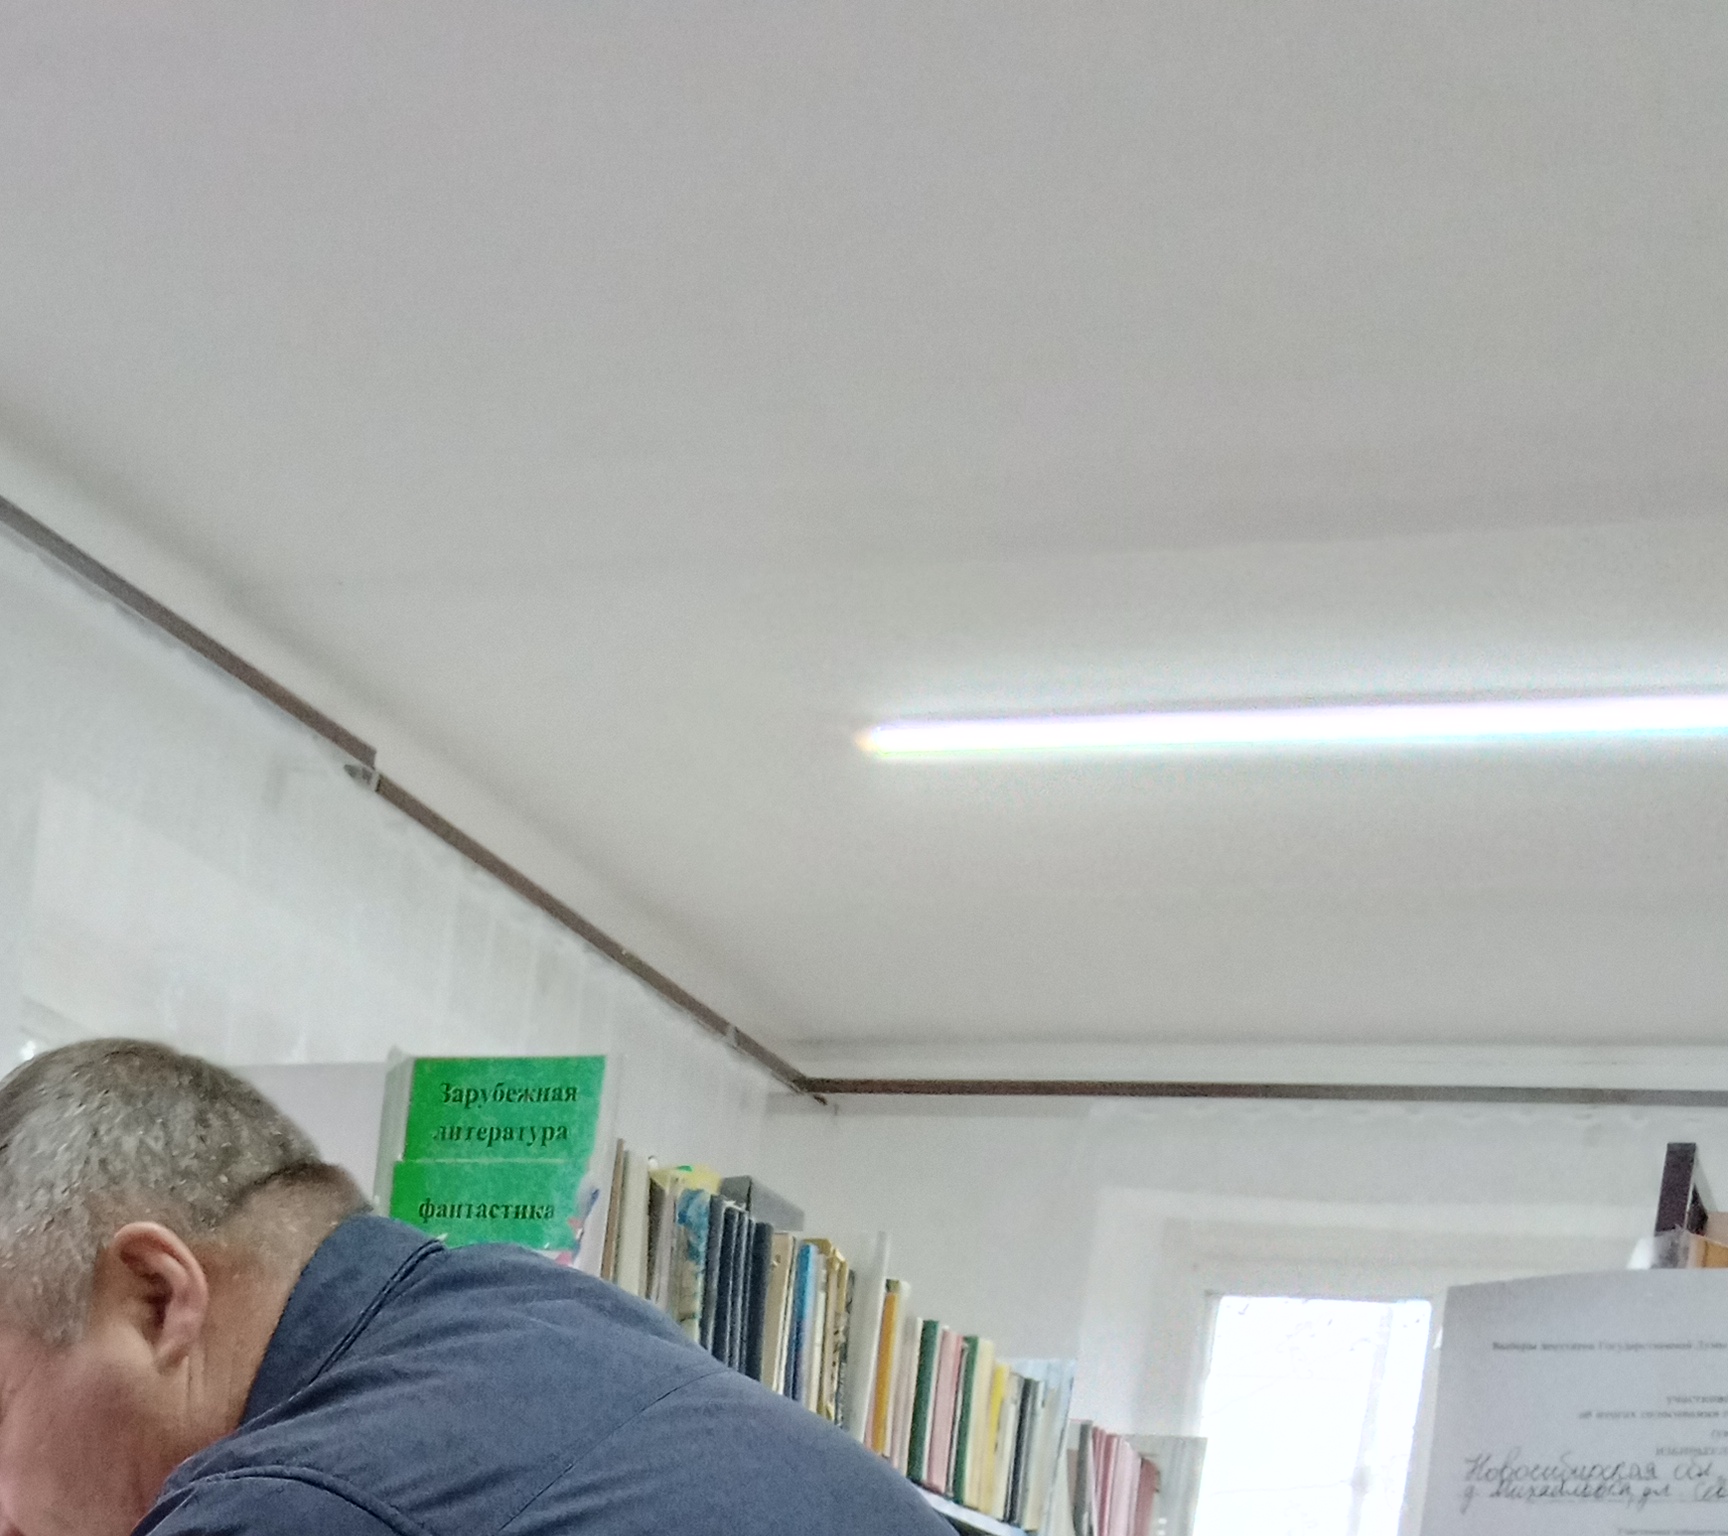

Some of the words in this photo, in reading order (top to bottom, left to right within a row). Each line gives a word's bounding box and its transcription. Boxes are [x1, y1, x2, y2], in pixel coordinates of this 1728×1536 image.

[440, 1082, 579, 1109] Зарубежная
[431, 1121, 569, 1148] литература
[418, 1197, 556, 1224] фантастика
